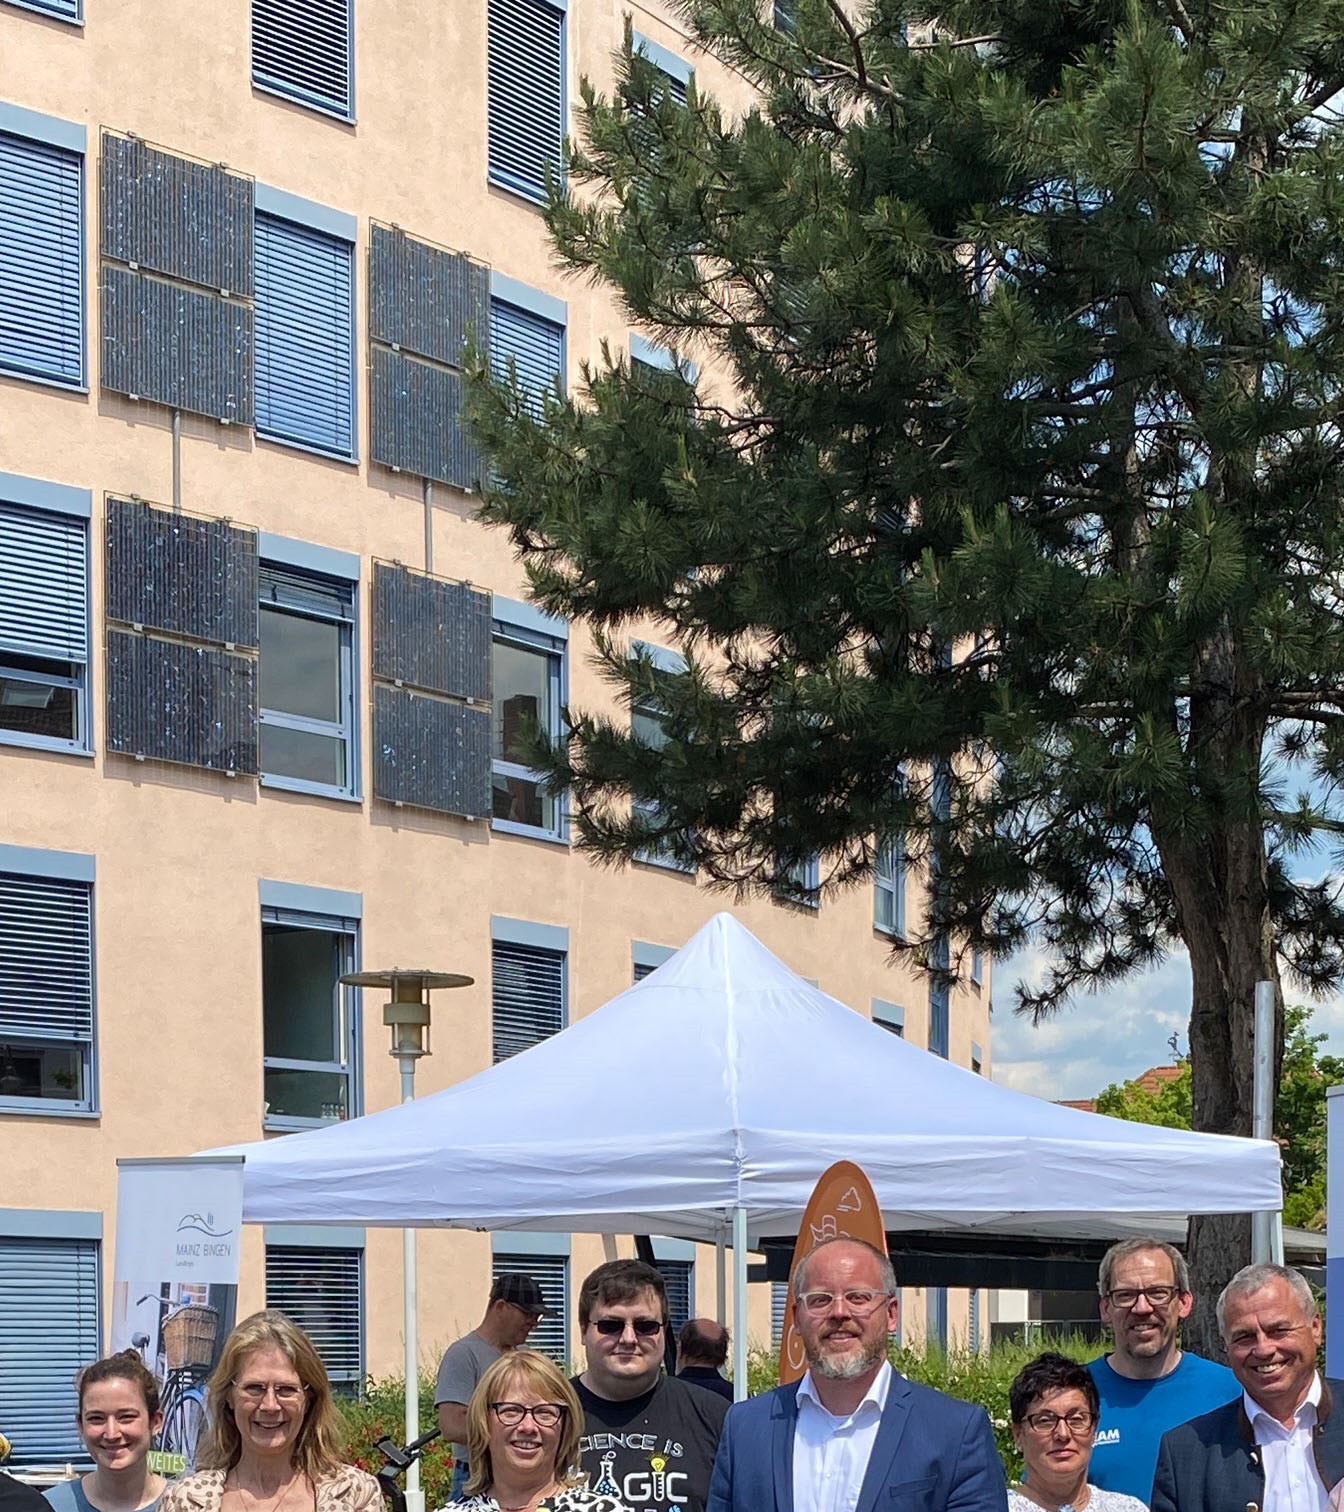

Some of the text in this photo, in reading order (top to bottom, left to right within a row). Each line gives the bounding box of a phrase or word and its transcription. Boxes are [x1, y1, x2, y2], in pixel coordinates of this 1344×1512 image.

[176, 1243, 231, 1256] MAINZ BINGEN
[578, 1432, 684, 1458] CIENCE IS
